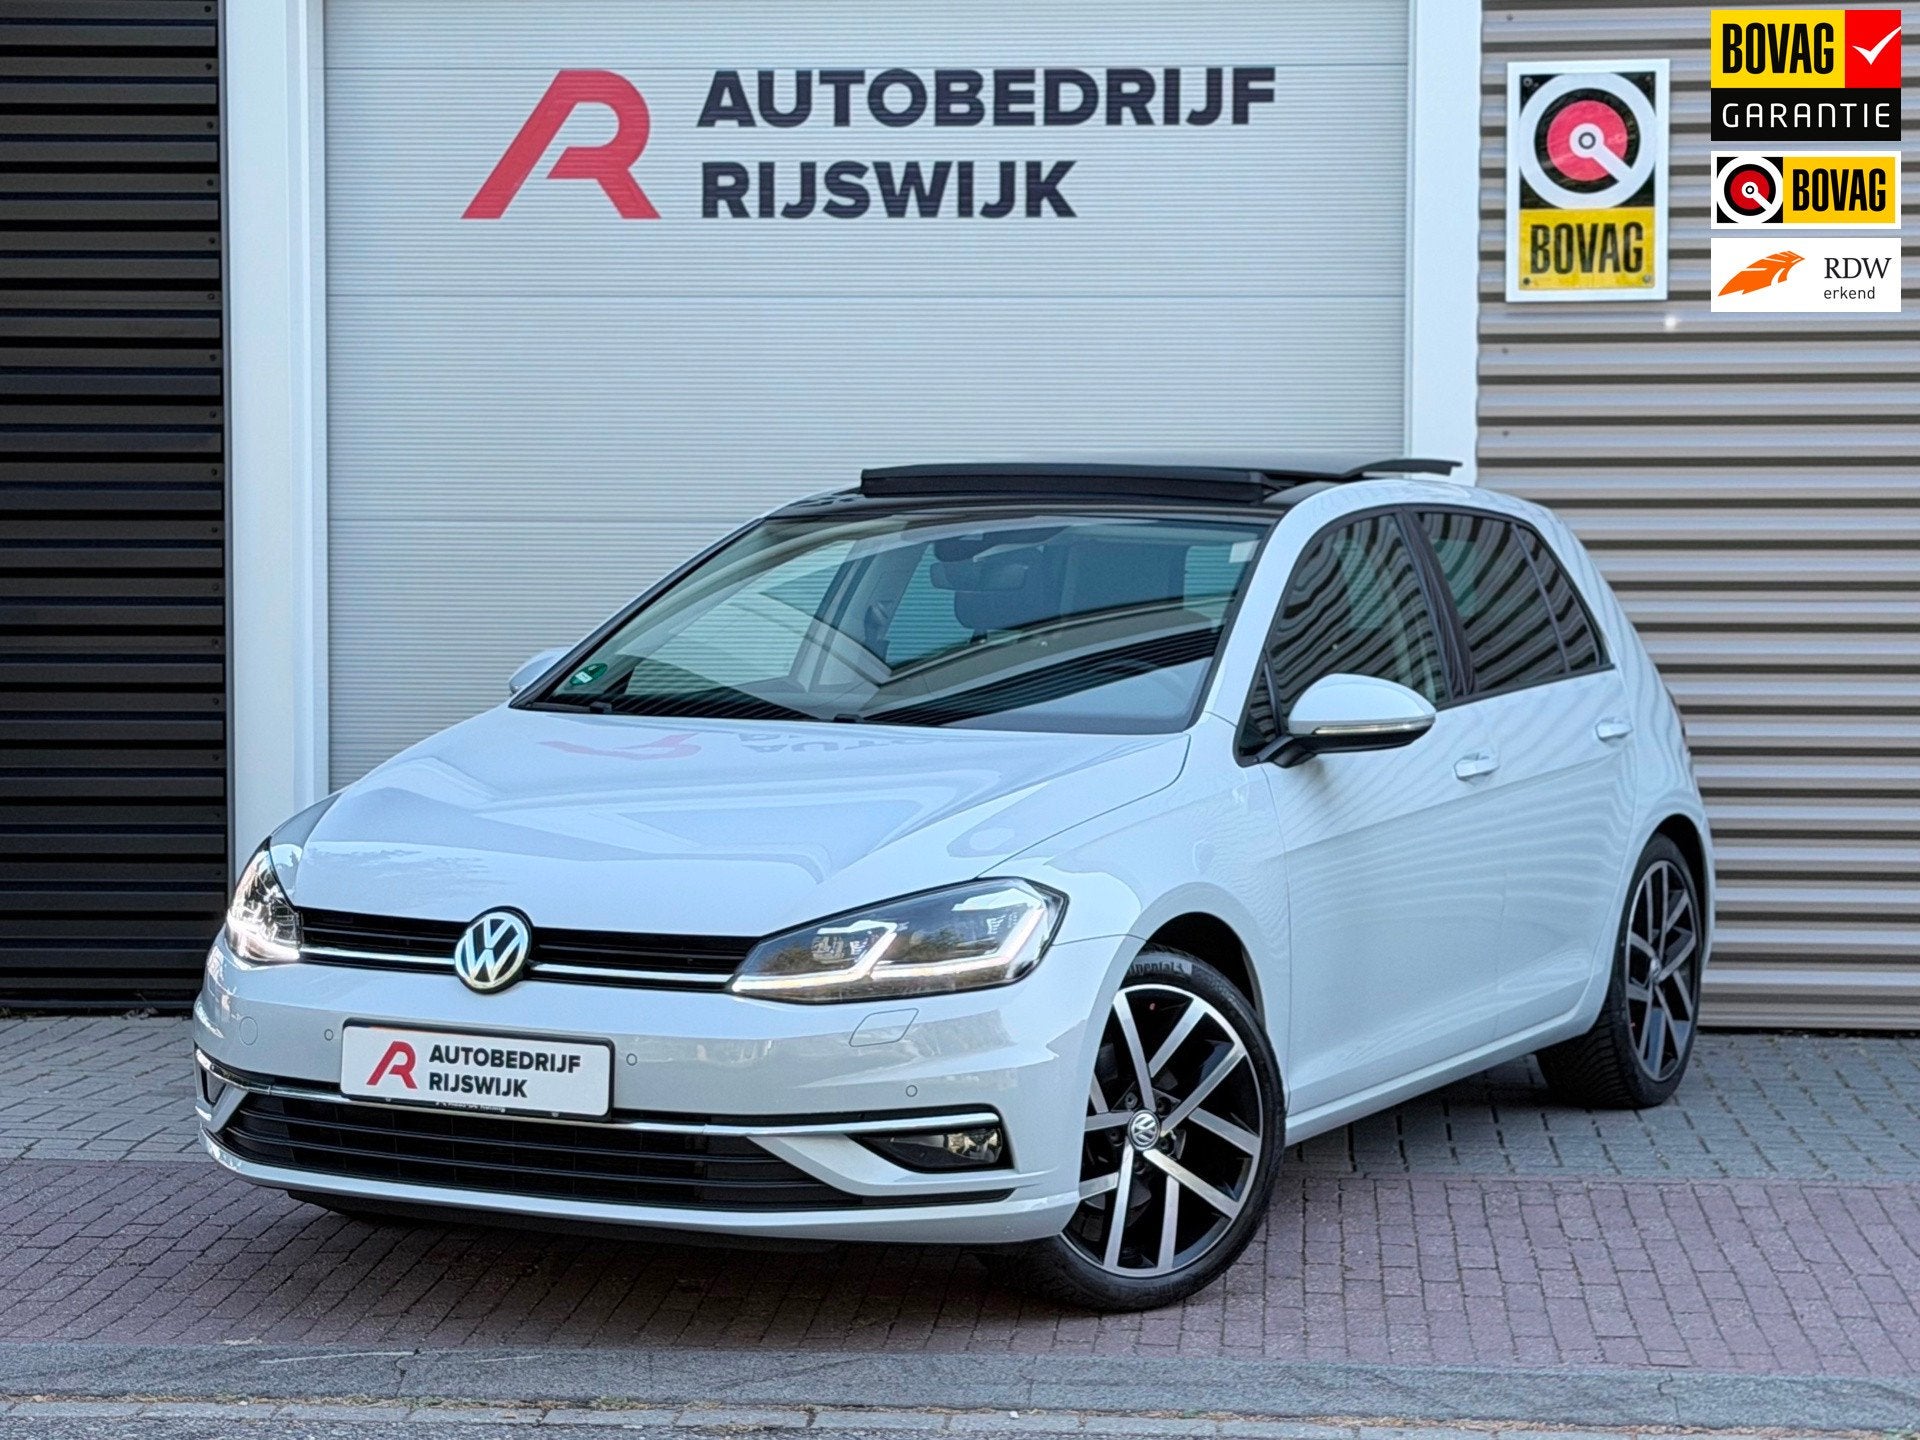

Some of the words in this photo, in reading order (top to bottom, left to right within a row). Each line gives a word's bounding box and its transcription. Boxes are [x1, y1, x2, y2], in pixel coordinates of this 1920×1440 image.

[696, 66, 1276, 128] AUTOBEDRIJF
[701, 160, 1077, 219] RIJSWIJK
[1530, 221, 1643, 275] BOVAG
[429, 1044, 581, 1074] AUTOBEDRIJF
[429, 1072, 528, 1098] RIJSWIJK
